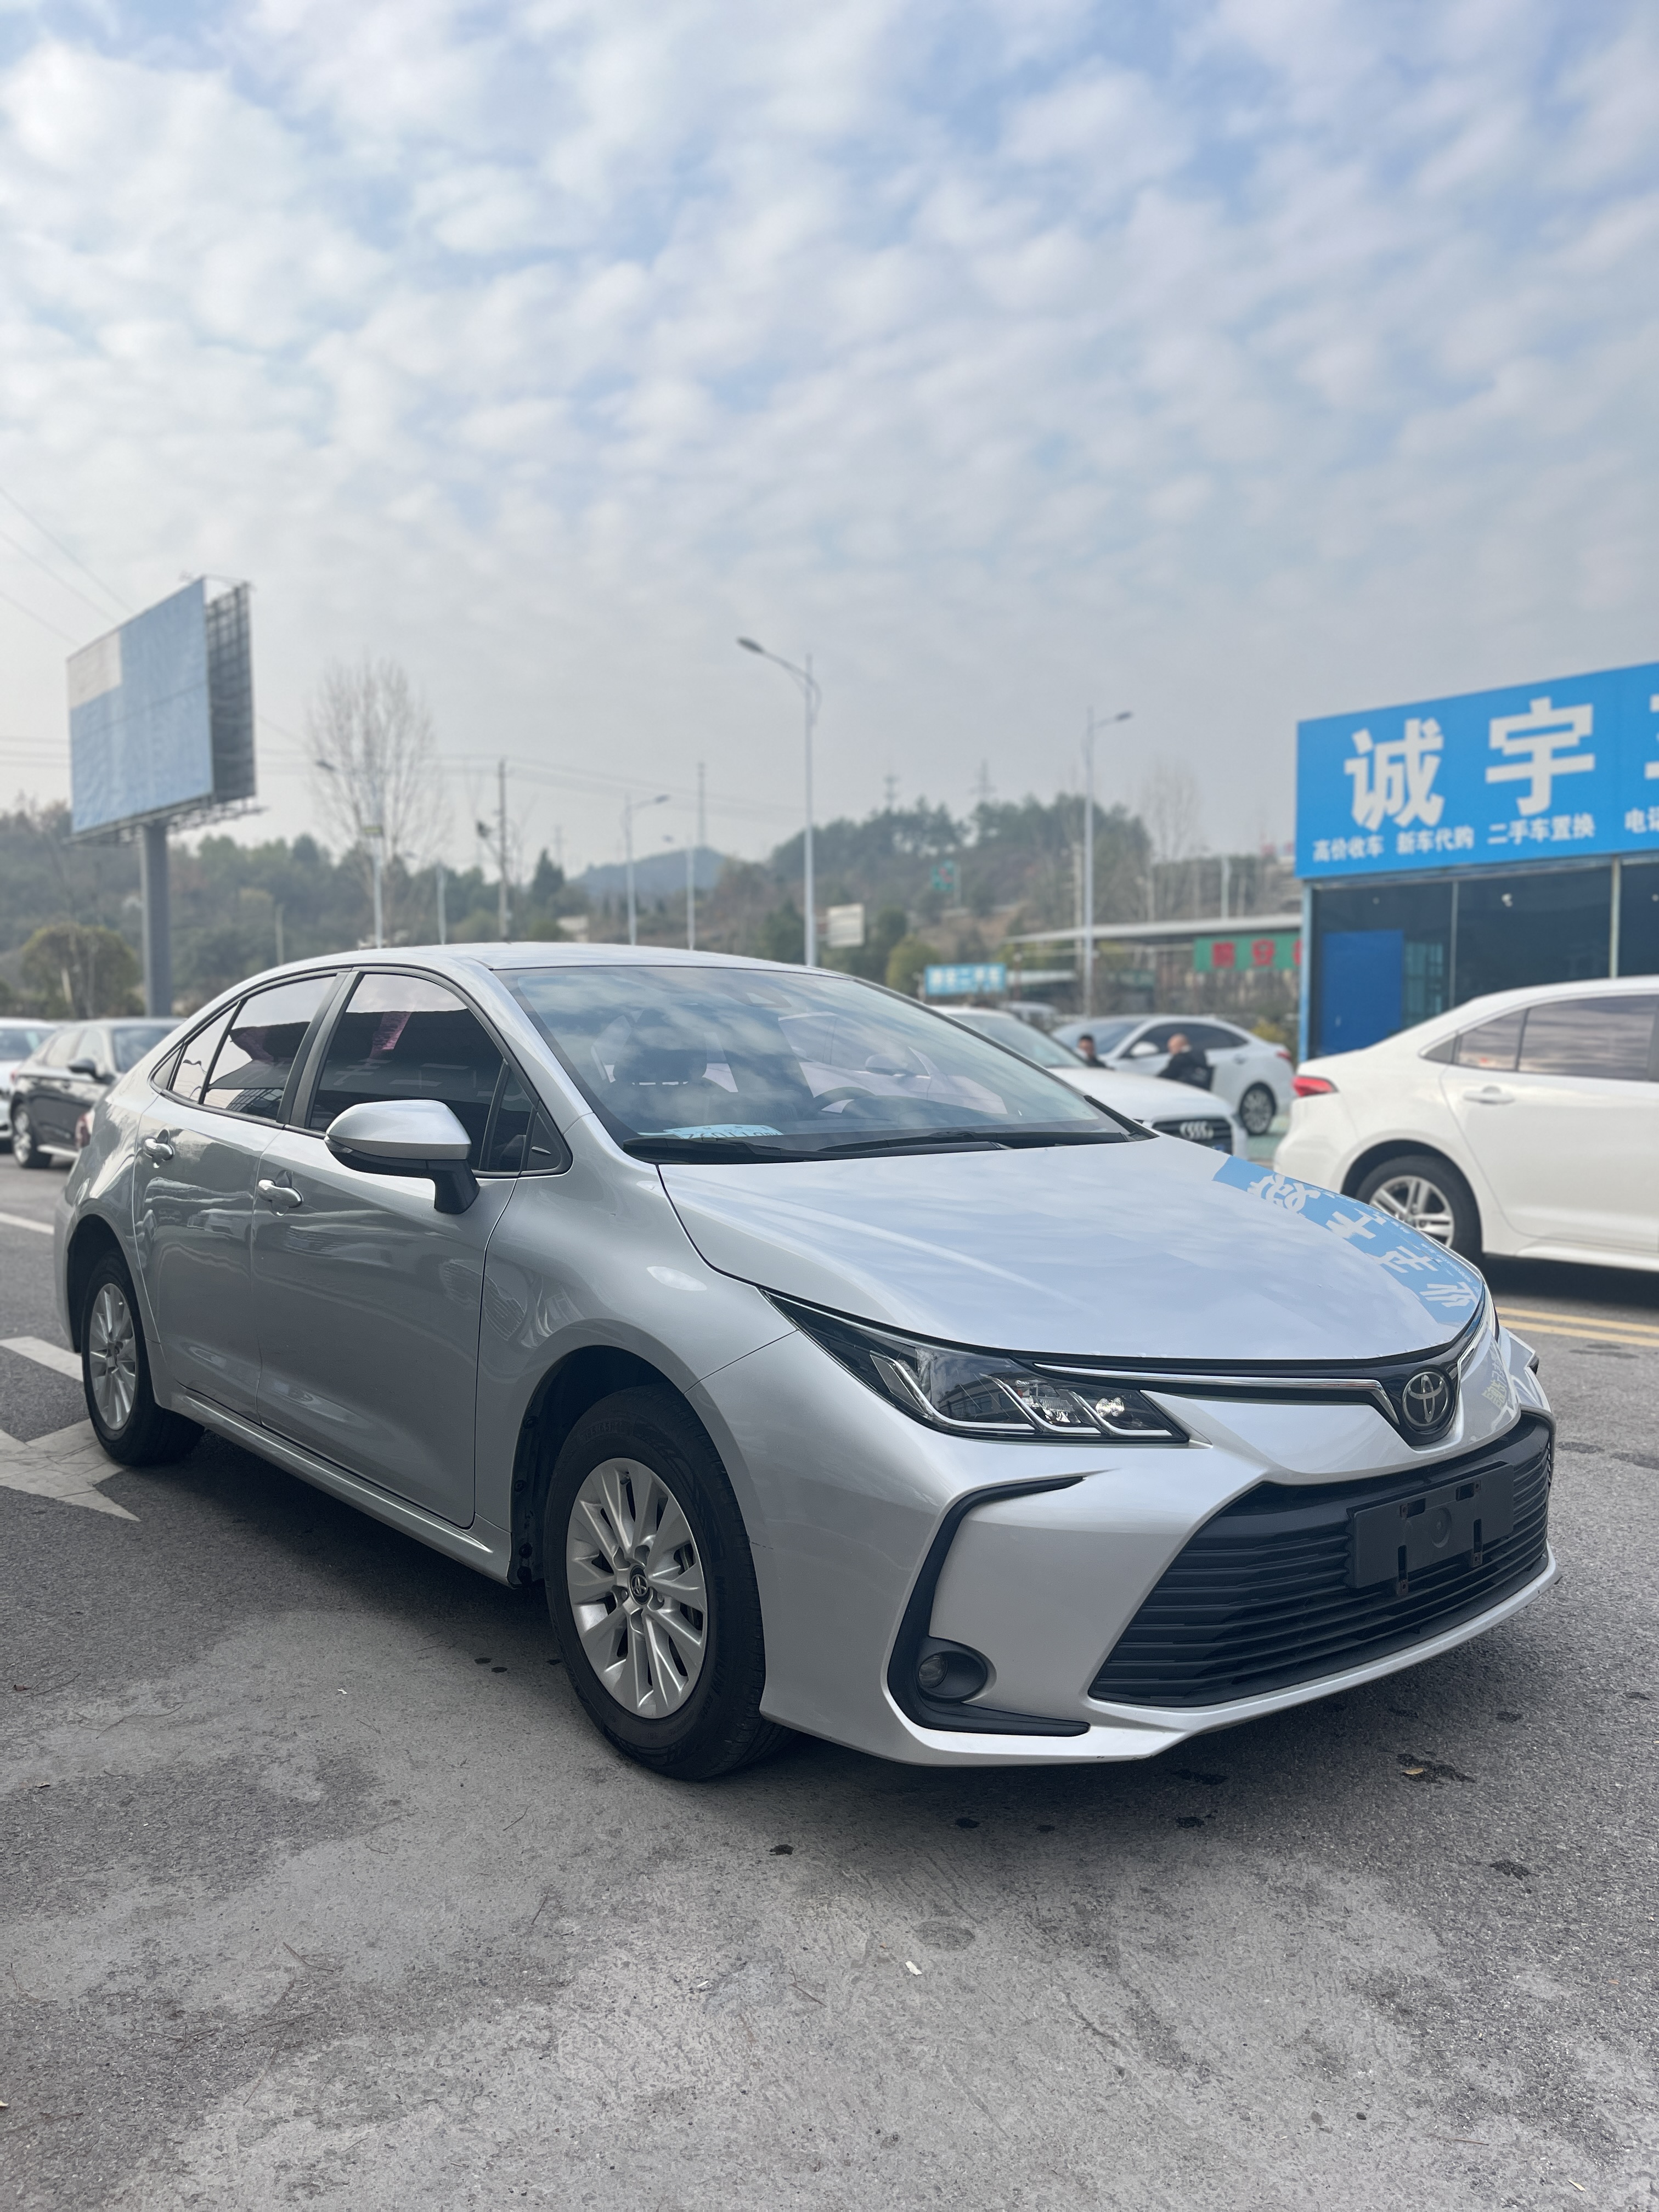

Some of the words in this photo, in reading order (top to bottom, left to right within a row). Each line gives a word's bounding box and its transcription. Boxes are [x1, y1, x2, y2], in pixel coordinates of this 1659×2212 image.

[1344, 693, 1659, 833] 诚宇
[1487, 812, 1594, 845] 二手车置换
